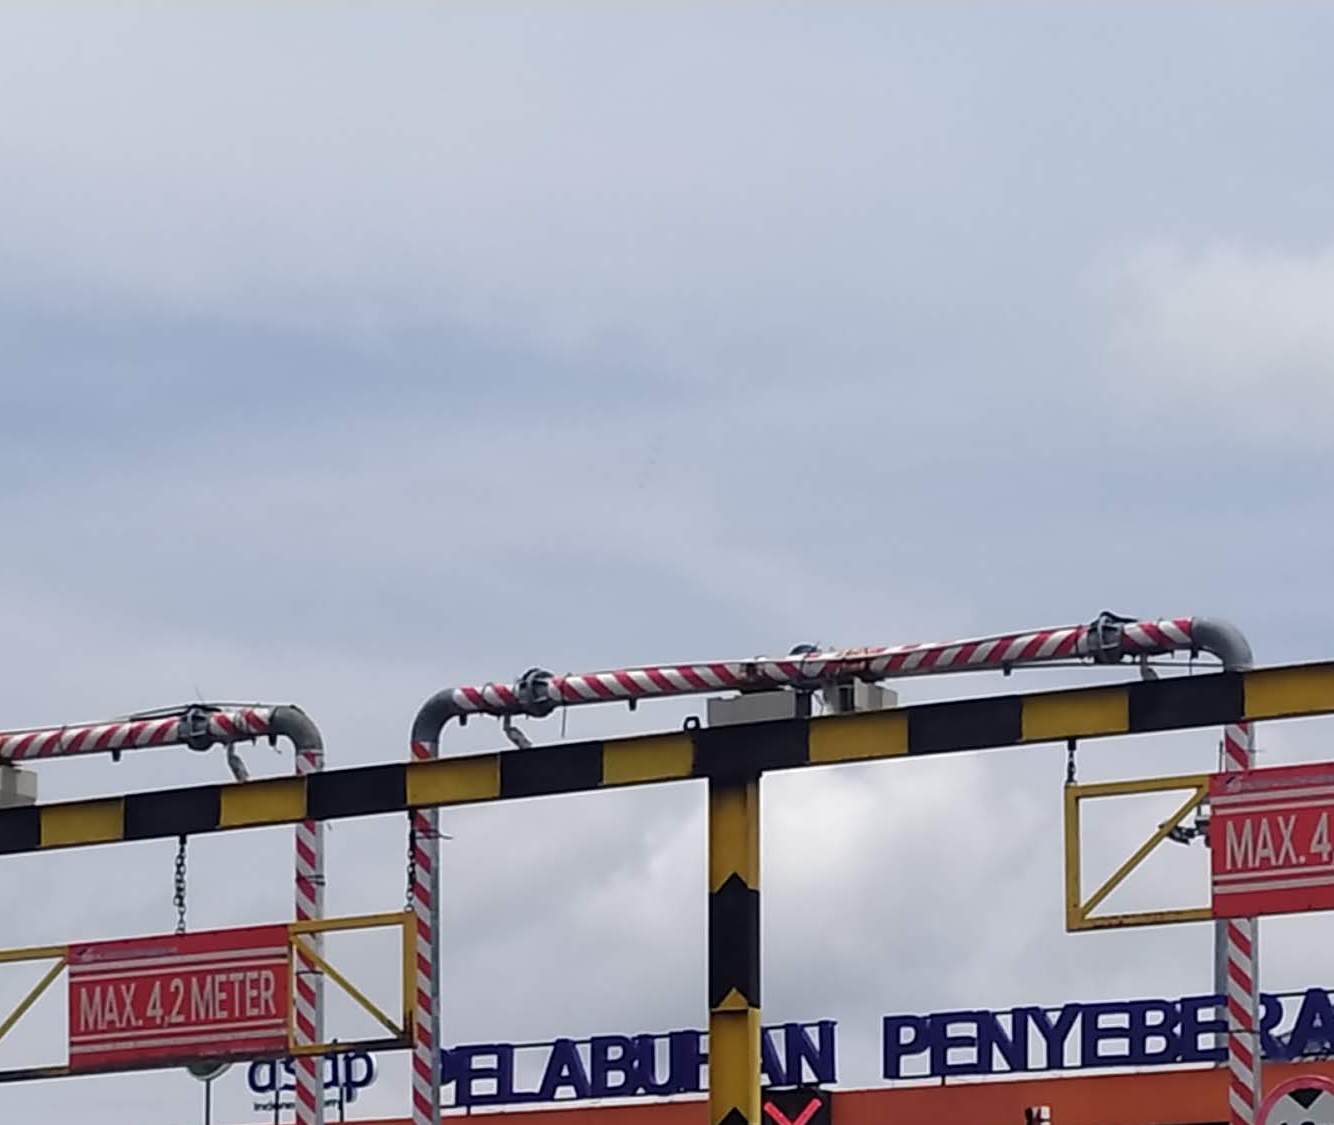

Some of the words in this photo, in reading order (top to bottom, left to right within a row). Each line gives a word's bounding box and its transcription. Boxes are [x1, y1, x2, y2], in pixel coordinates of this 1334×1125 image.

[1225, 814, 1306, 871] MAX.
[79, 982, 144, 1033] MAX.
[146, 977, 186, 1028] 4,2
[190, 970, 277, 1022] METER
